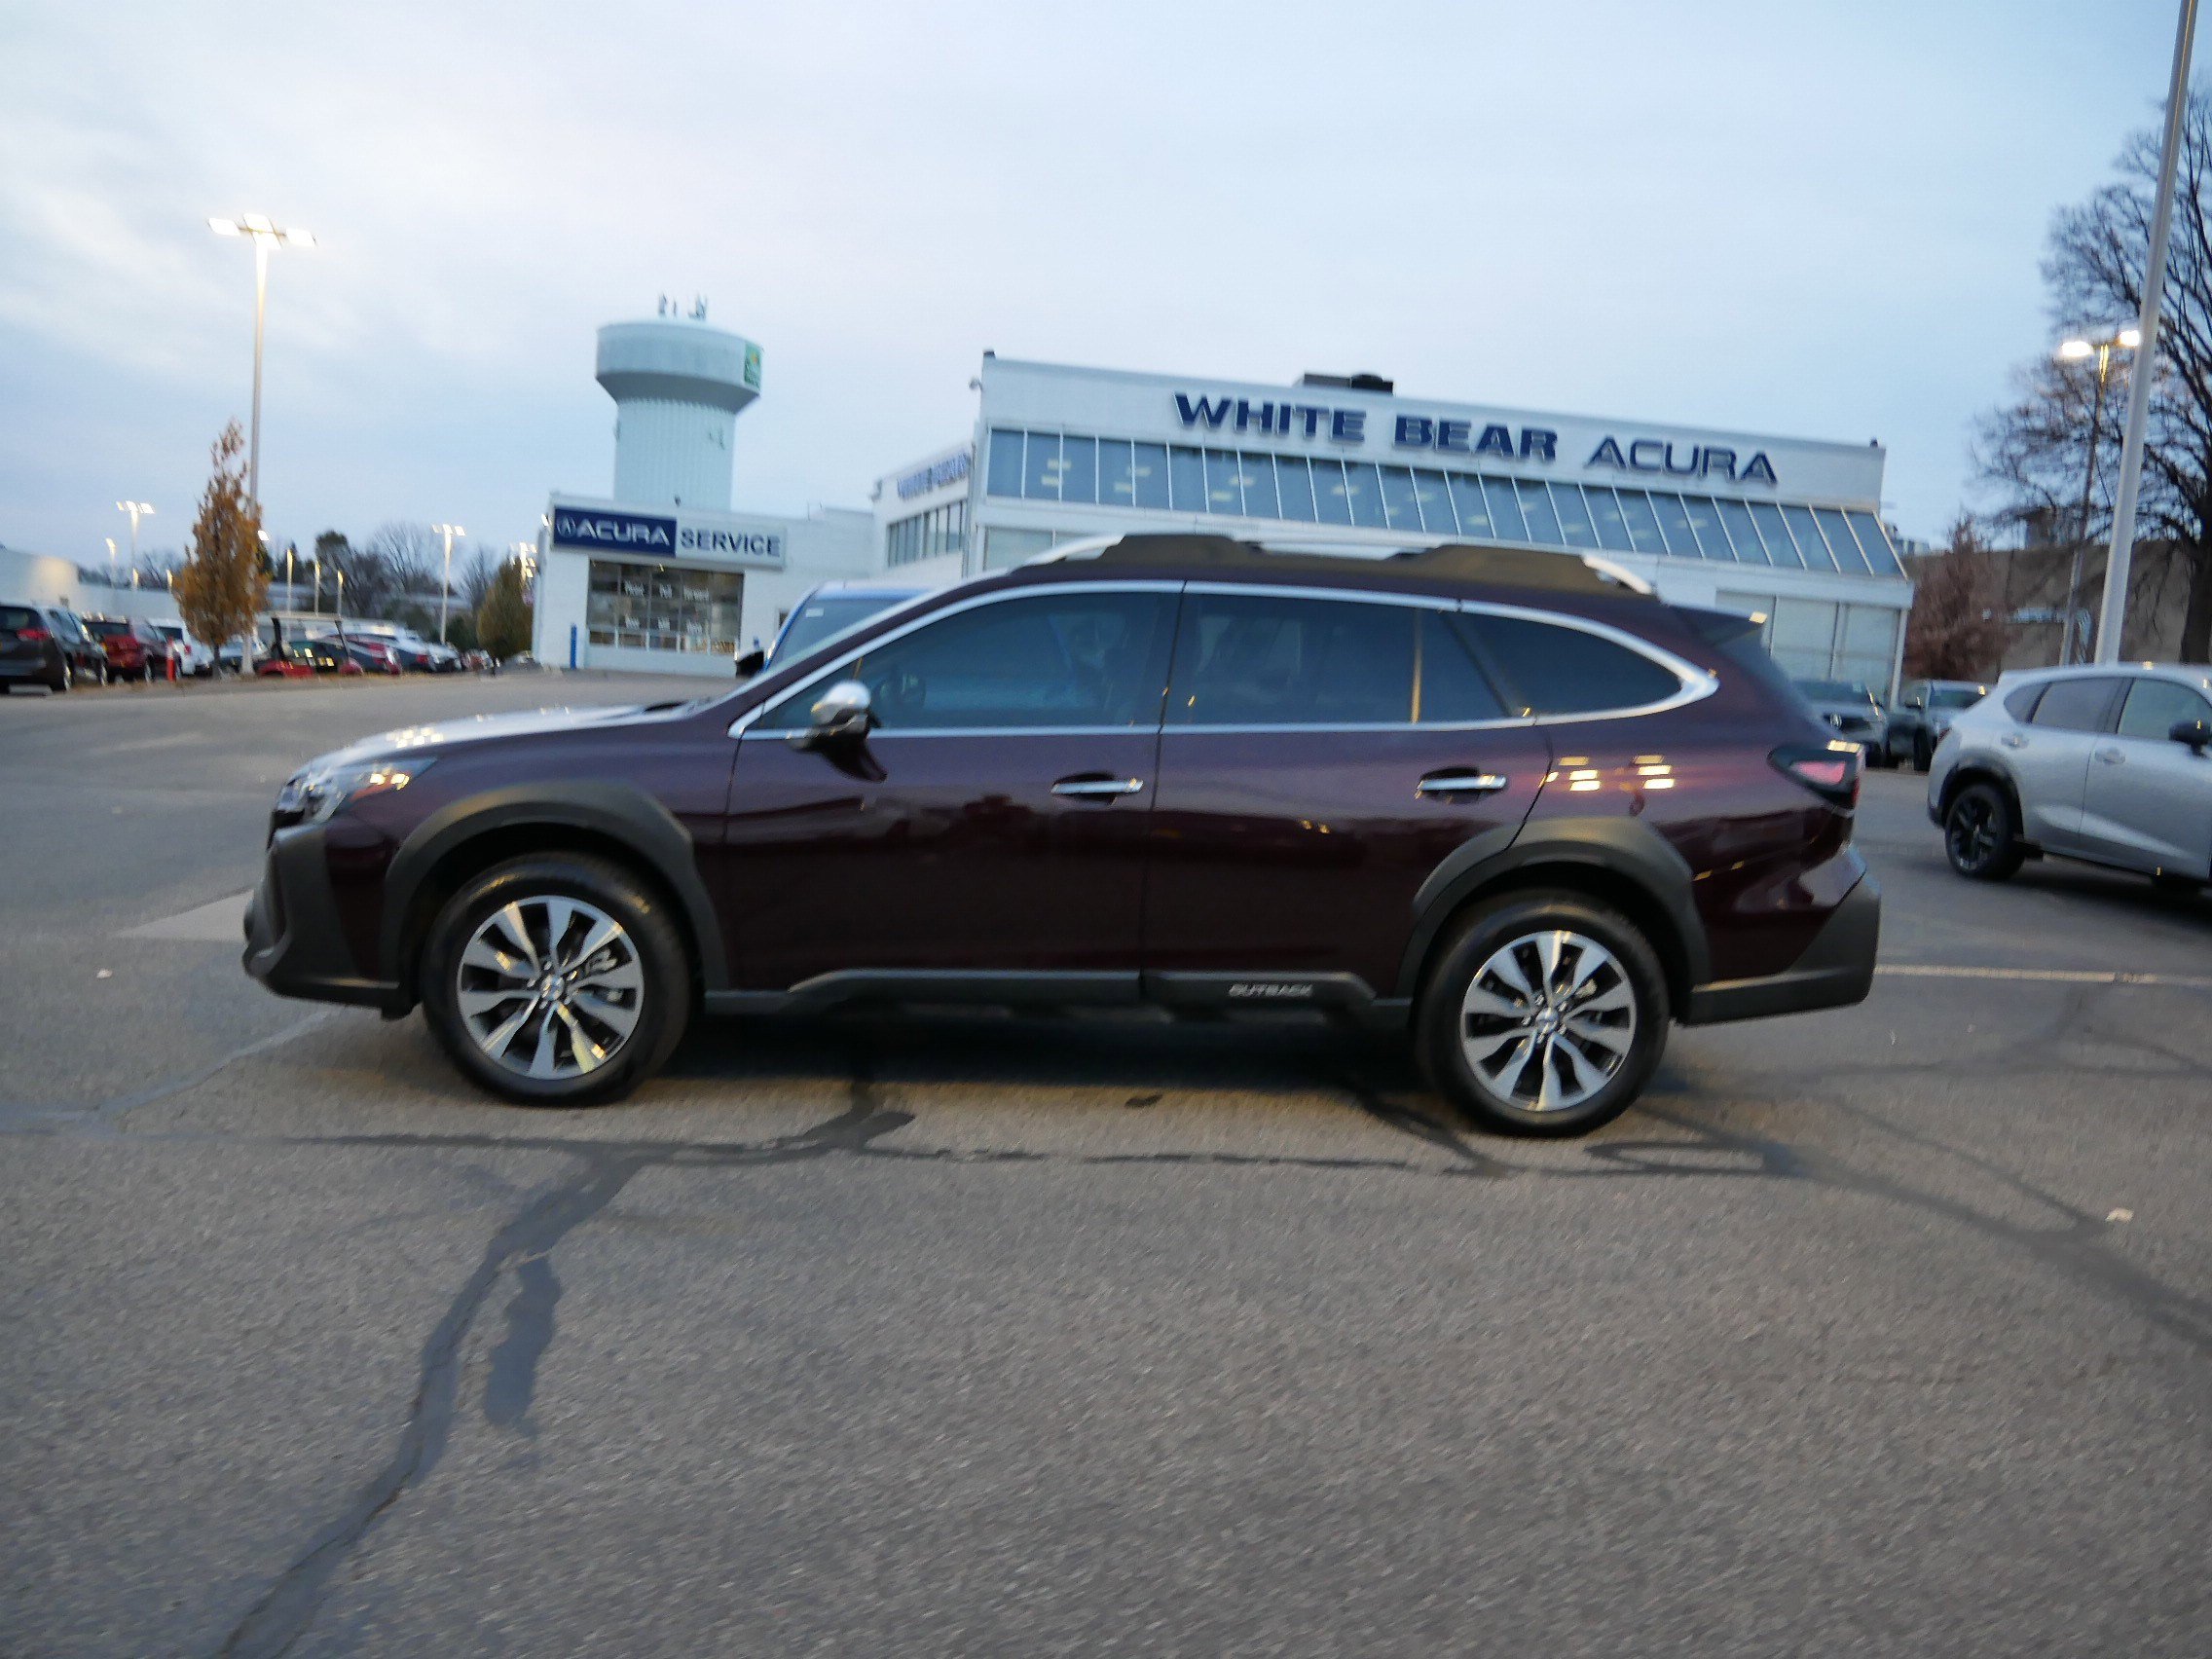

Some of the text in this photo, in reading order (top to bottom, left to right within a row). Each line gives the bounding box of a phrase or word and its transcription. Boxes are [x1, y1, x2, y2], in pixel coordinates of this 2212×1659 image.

[1174, 392, 1779, 486] WHITE BEAR ACURA
[576, 519, 780, 558] ACURA SERVICE
